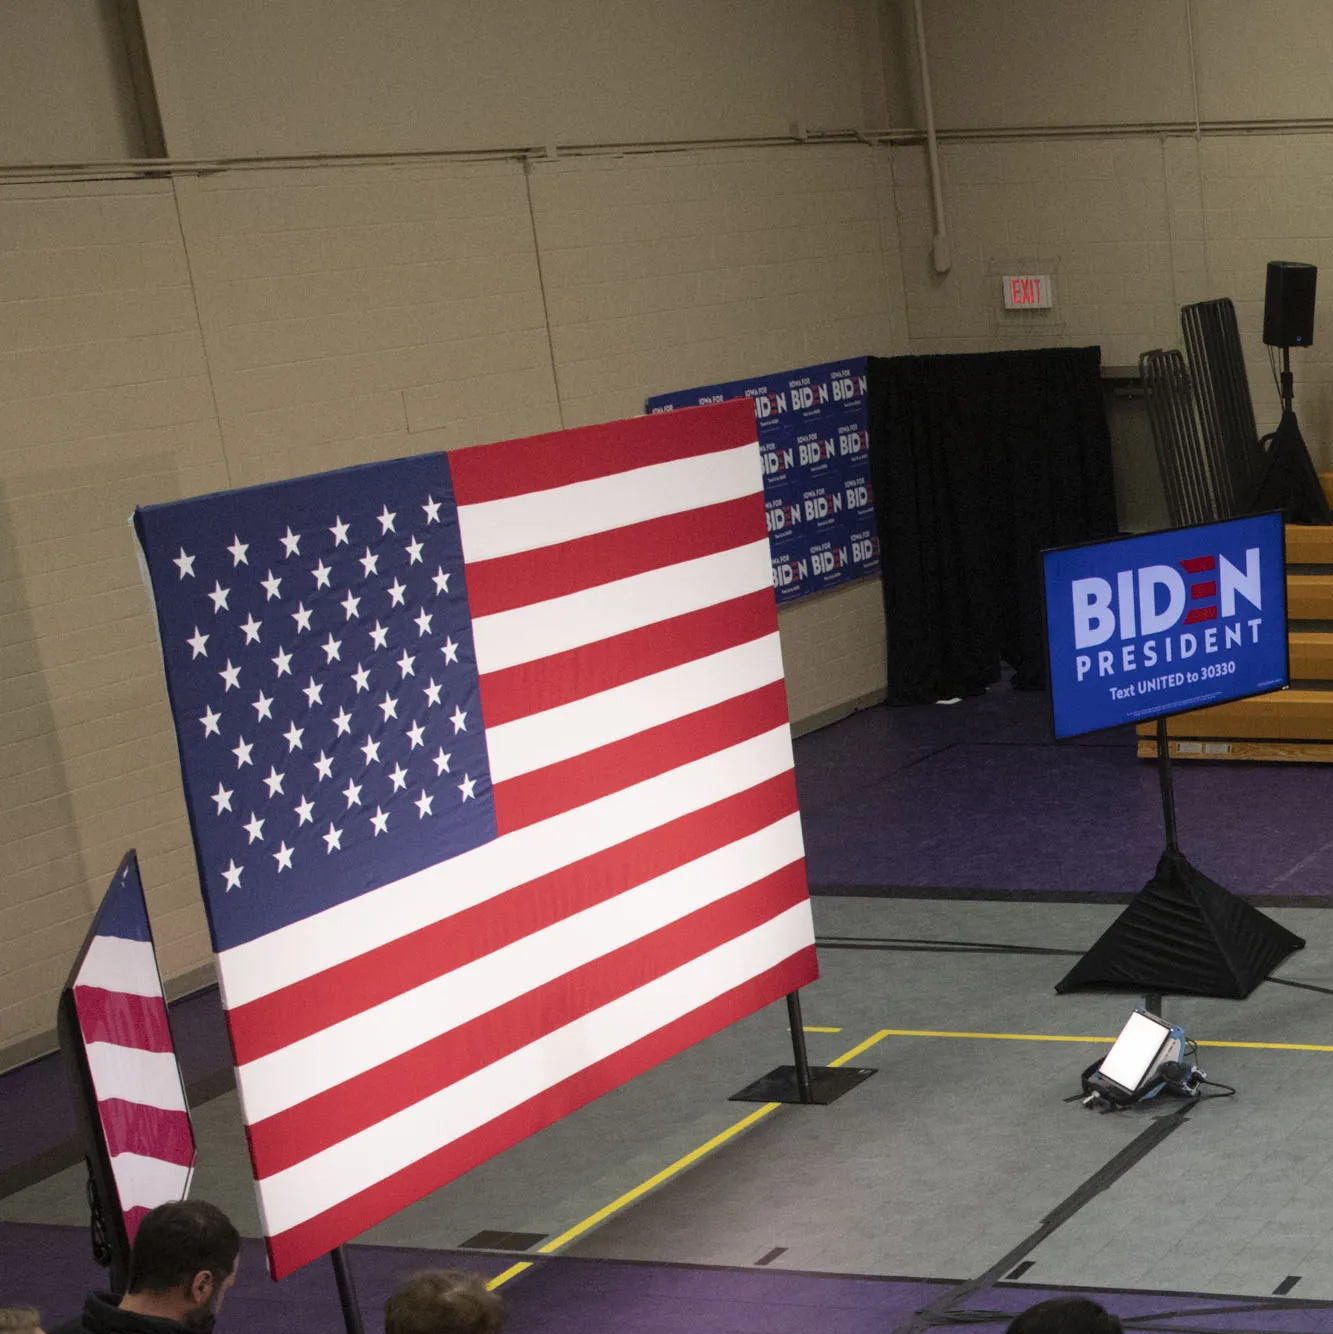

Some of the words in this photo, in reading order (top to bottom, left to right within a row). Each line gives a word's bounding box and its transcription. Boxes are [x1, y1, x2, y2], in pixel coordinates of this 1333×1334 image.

[1011, 278, 1041, 305] EXIT
[790, 383, 829, 411] BIDEN
[831, 375, 868, 402] BIDEN
[755, 392, 787, 418] IDEN
[798, 438, 835, 466] BIDEN
[804, 492, 842, 521] BIDEN
[846, 483, 873, 510] BIDE
[811, 546, 848, 576] BIDEN
[852, 536, 880, 564] BIDE
[1071, 547, 1262, 650] BIDEN
[1075, 618, 1262, 682] PRESIDENT
[1109, 684, 1135, 701] Text
[1137, 672, 1185, 694] UNITED
[1186, 671, 1199, 683] to
[1200, 660, 1236, 681] 30330
